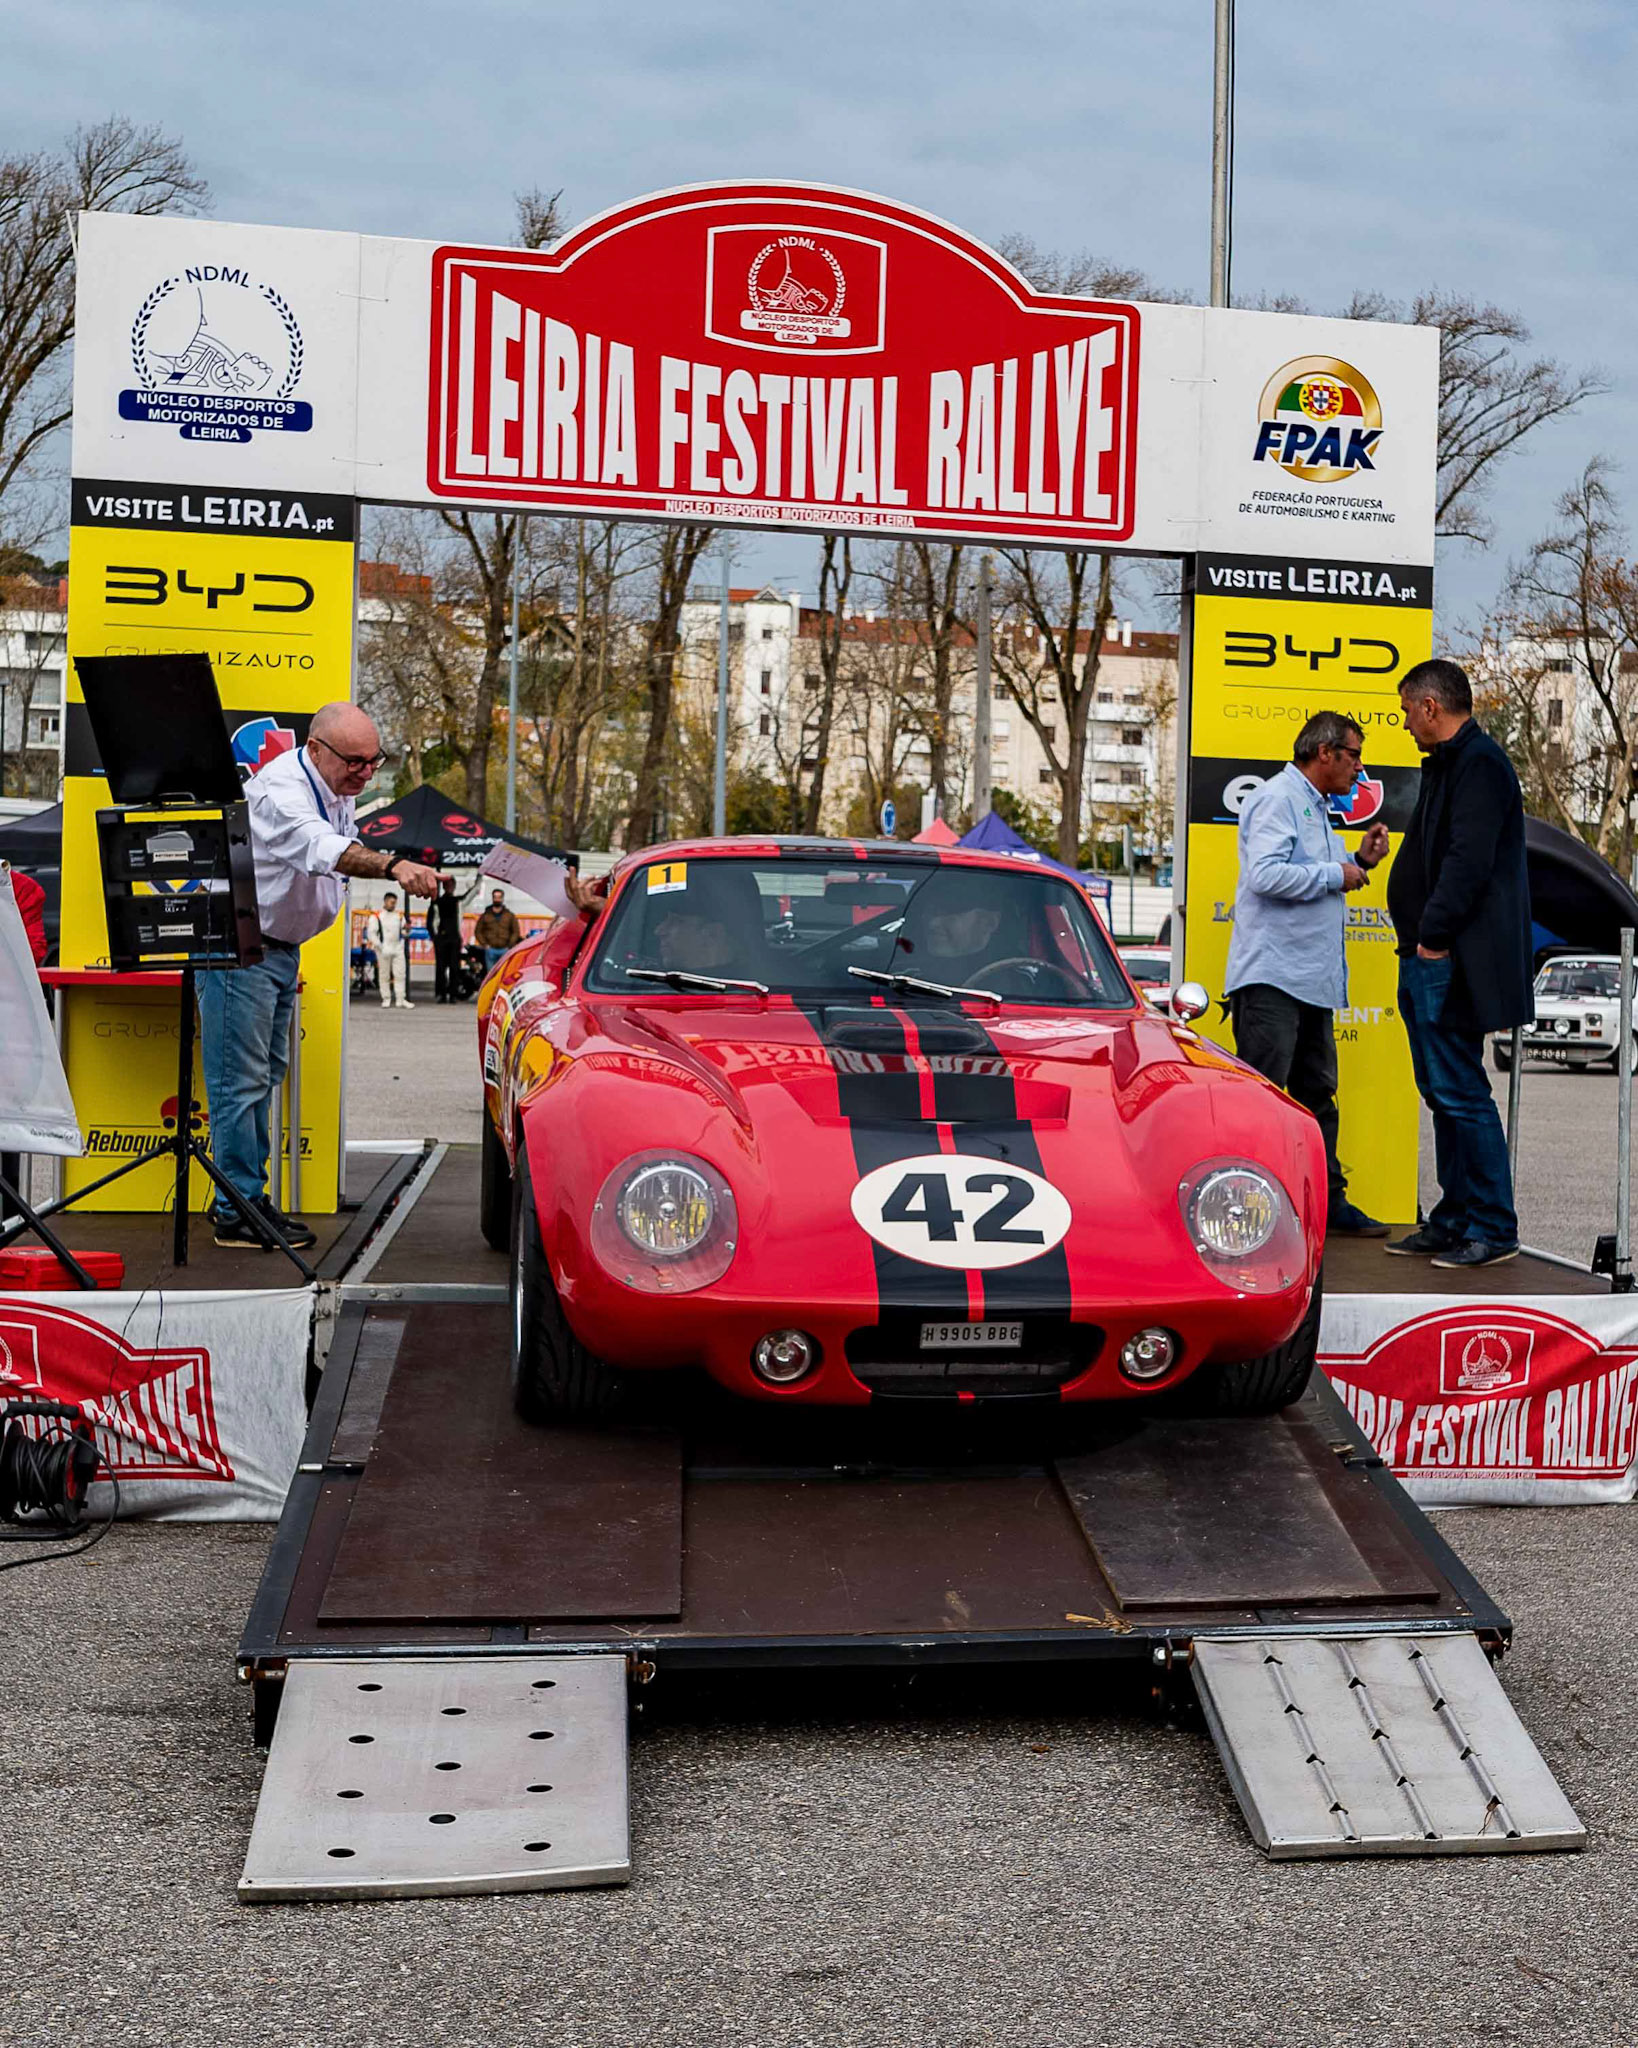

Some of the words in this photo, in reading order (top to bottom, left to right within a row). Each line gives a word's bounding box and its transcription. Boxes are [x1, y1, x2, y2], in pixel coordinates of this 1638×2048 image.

[778, 236, 816, 251] NDML
[185, 265, 250, 289] NDML
[821, 327, 834, 335] DE
[203, 397, 297, 415] DESPORTOS
[456, 271, 639, 487] LEIRIA
[659, 355, 909, 508] FESTIVAL
[926, 326, 1118, 520] RALLYE
[148, 408, 260, 427] MOTORIZADOS
[263, 415, 284, 429] DE
[191, 426, 241, 441] LEIRIA
[1252, 421, 1385, 471] FPAK
[86, 496, 174, 521] VISITE
[1252, 490, 1313, 505] FEDERAÇÃO
[1315, 494, 1383, 510] PORTUGUESA
[713, 502, 780, 520] DESPORTOS
[781, 507, 861, 525] MOTORIZADOS
[862, 513, 878, 526] DE
[879, 514, 916, 529] LEIRIA
[1238, 502, 1253, 514] DE
[1254, 503, 1340, 520] AUTOMOBILISMO
[1341, 510, 1349, 520] E
[1350, 511, 1396, 524] KARTING
[105, 565, 315, 613] BYD
[1208, 566, 1282, 591] VISITE
[1224, 630, 1400, 674] BYD
[662, 866, 672, 884] 1
[881, 1173, 1046, 1245] 42
[925, 1327, 935, 1341] H
[940, 1327, 982, 1341] 9905
[1405, 1397, 1533, 1467] FESTIVAL
[1542, 1359, 1638, 1468] RALLYE
